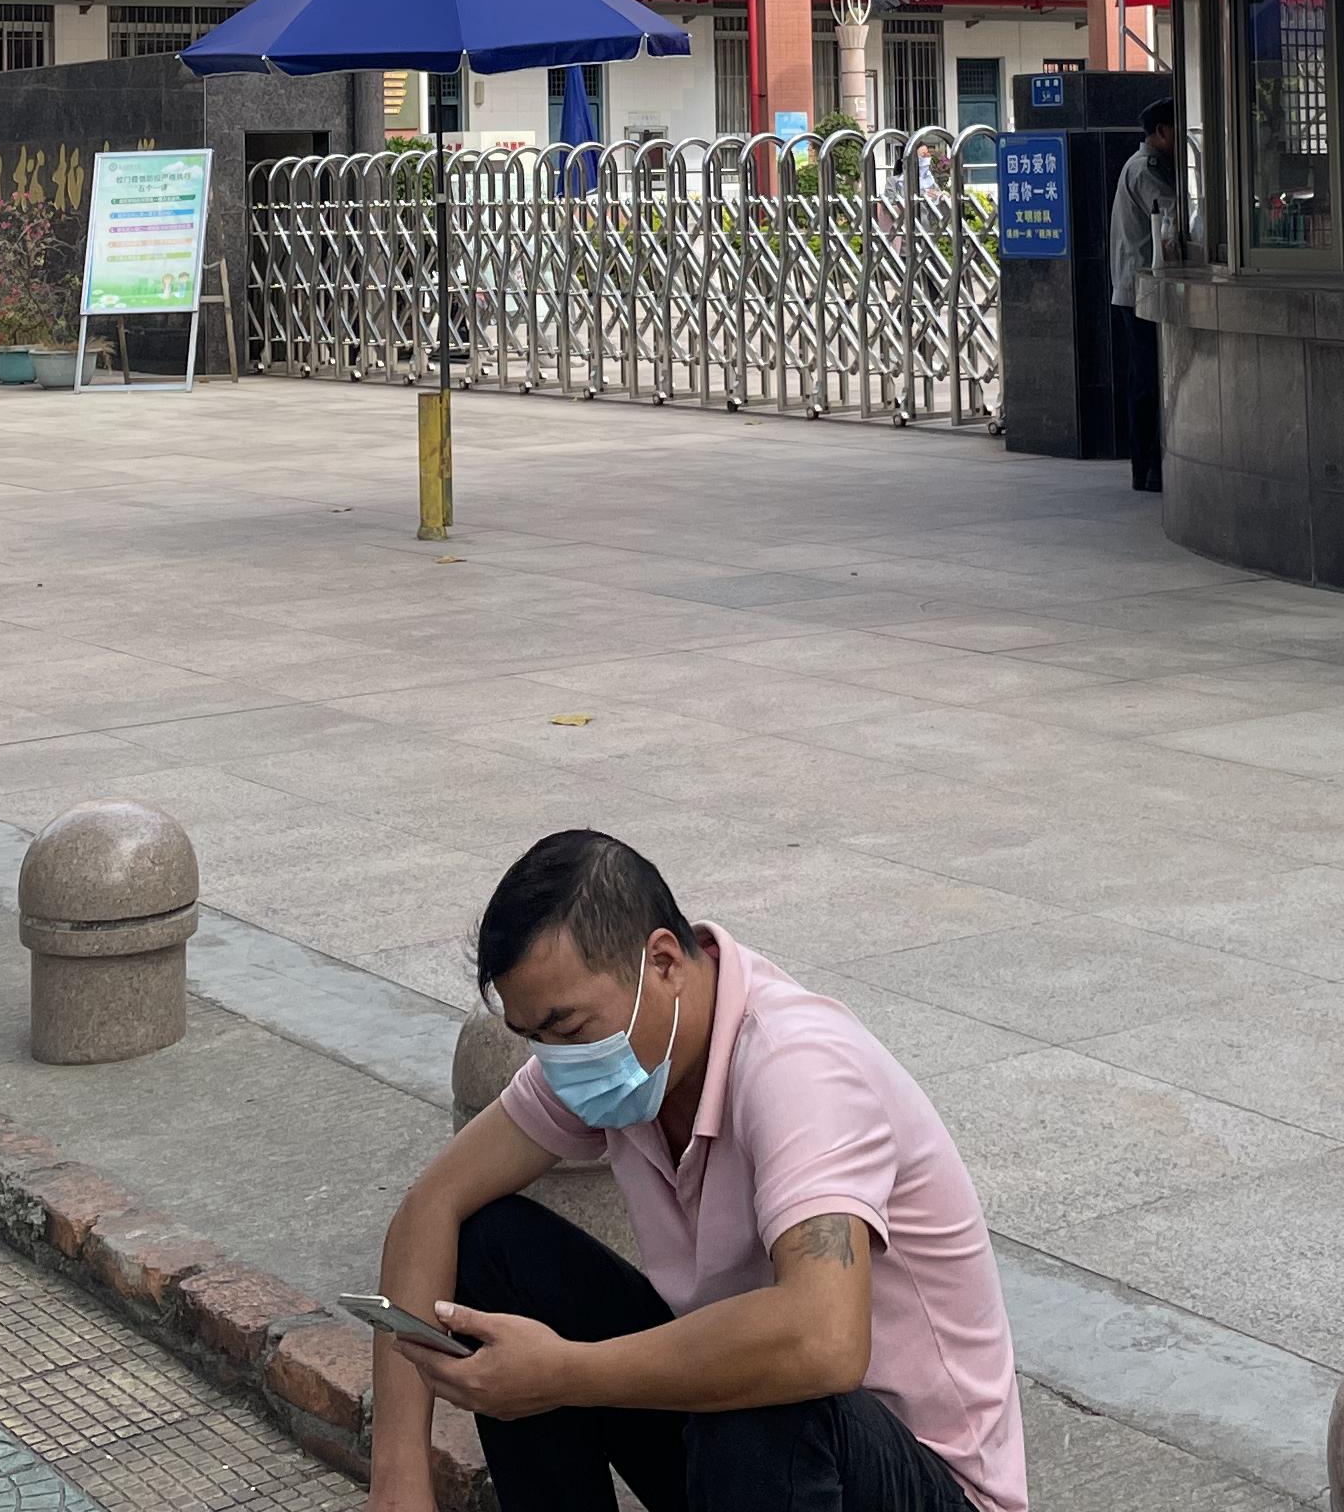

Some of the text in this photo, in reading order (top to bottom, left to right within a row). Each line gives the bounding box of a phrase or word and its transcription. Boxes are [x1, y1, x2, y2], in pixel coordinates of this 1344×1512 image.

[1007, 153, 1057, 175] 因为爱你
[1007, 181, 1059, 203] 离你一米
